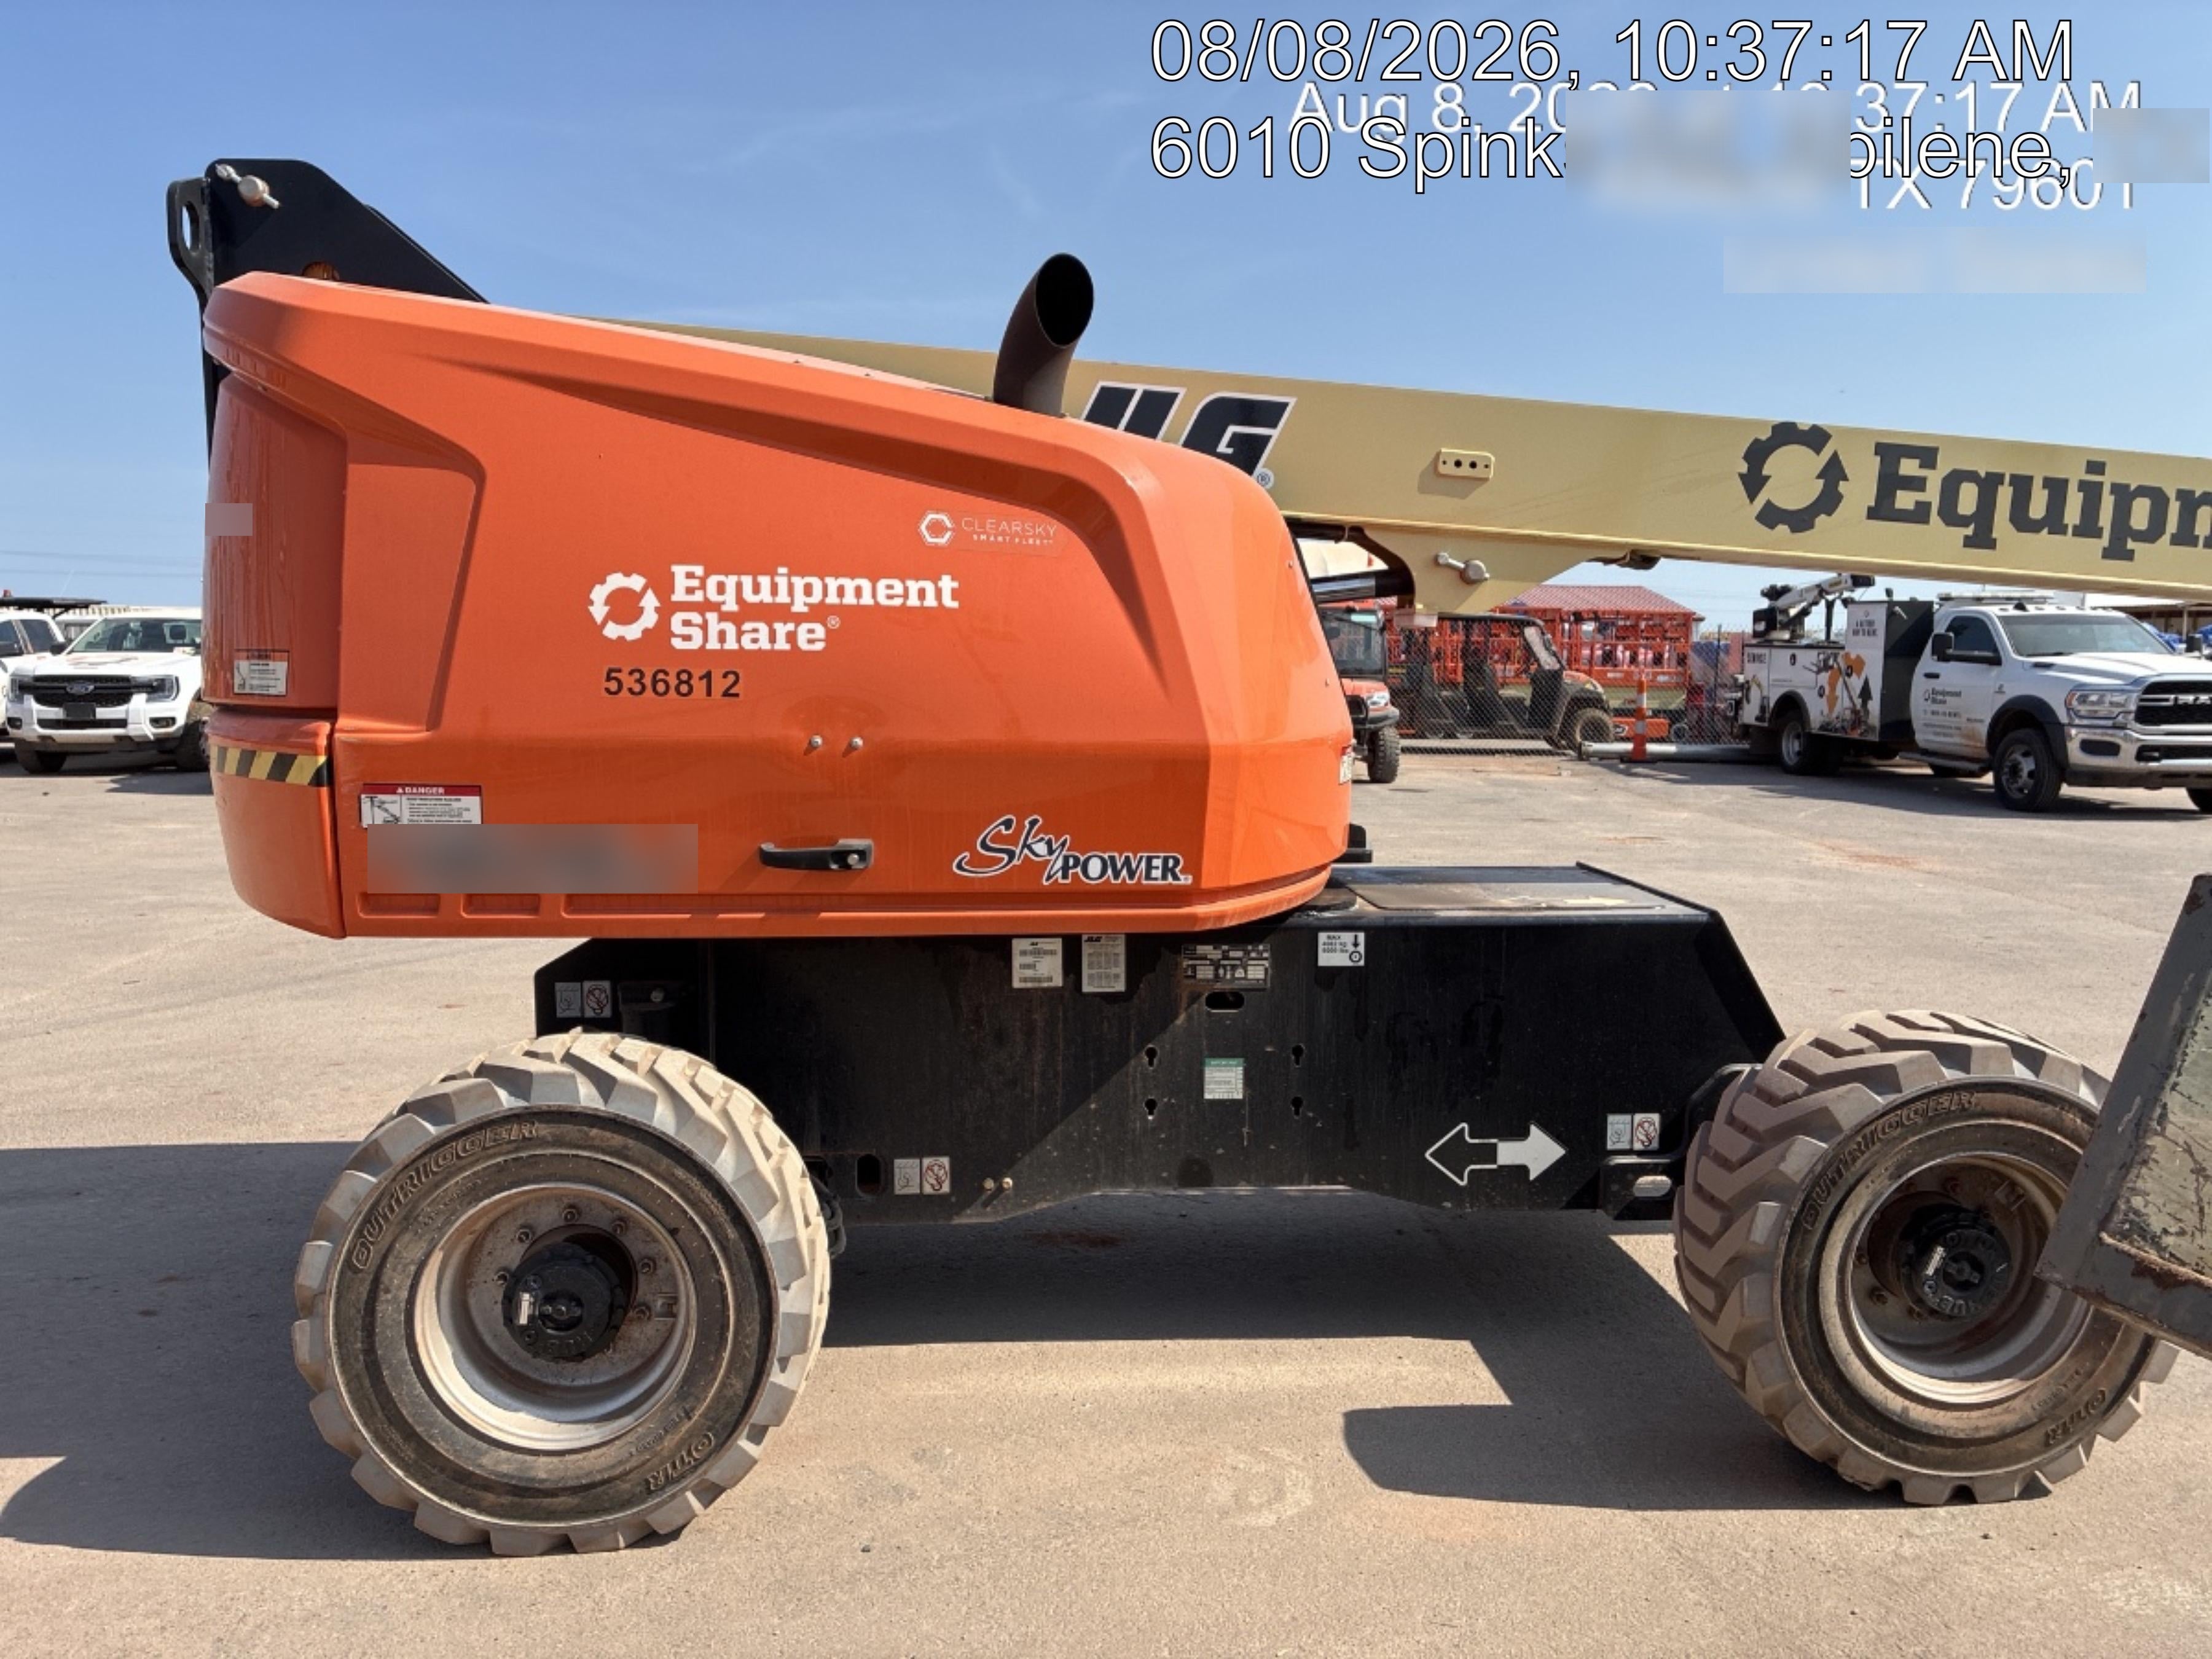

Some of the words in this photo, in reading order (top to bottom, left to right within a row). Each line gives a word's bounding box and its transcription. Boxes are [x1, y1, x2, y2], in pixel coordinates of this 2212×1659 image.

[961, 517, 1057, 538] CLEARSKY
[670, 564, 959, 613] Equipment
[603, 667, 740, 698] 536812
[351, 1120, 539, 1269] OUTRIGGER
